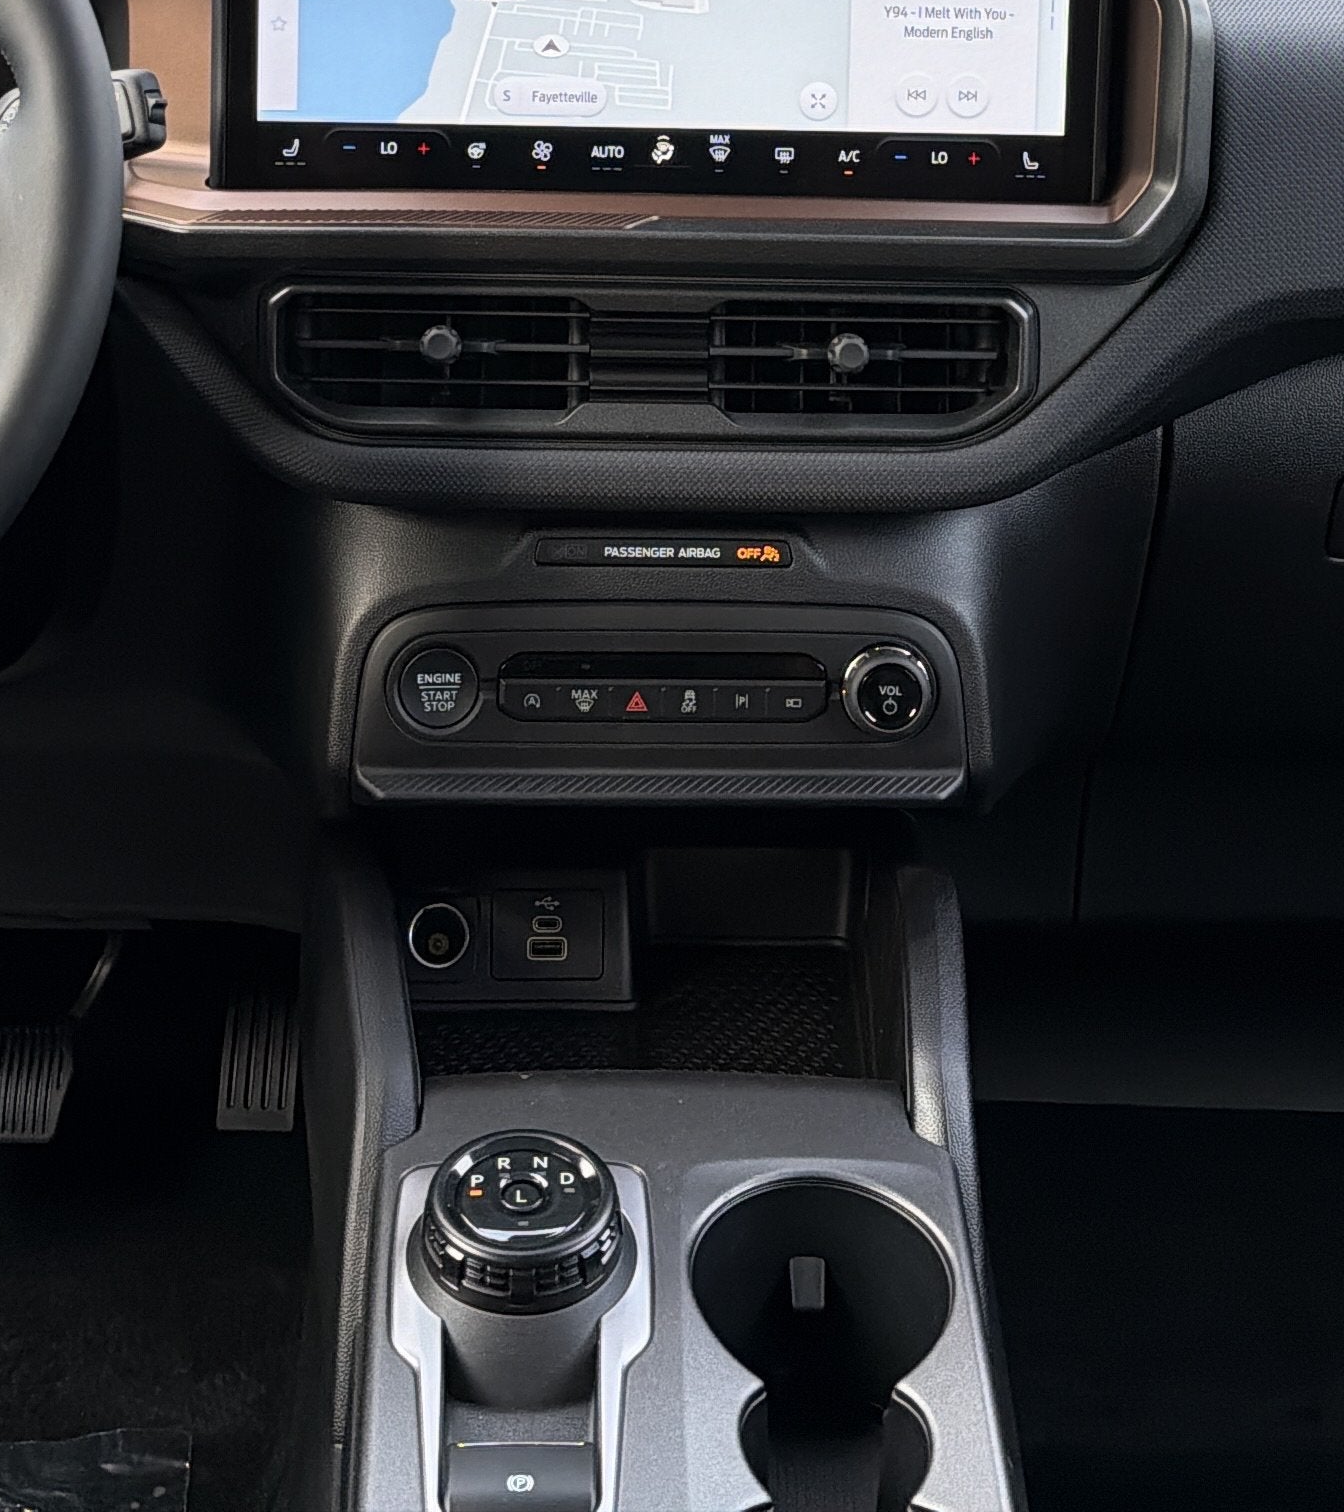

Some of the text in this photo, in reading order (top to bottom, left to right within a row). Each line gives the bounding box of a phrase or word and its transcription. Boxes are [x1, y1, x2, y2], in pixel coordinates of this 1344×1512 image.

[884, 6, 908, 20] Y94
[924, 7, 951, 21] Melt
[953, 7, 982, 21] With
[982, 7, 1008, 21] You
[903, 25, 994, 42] Modern English
[503, 89, 598, 106] S Fayetteville
[709, 134, 730, 146] MAX
[380, 141, 398, 156] LO
[591, 145, 625, 159] AUTO
[838, 149, 861, 164] A/C
[931, 151, 949, 165] LO
[603, 546, 721, 560] PASSENGER AIRBAG
[736, 547, 761, 560] OFF
[416, 672, 462, 685] ENGINE
[420, 690, 459, 702] START
[570, 689, 599, 701] MAX
[878, 685, 903, 697] VOL
[423, 700, 456, 713] STOP
[680, 704, 698, 714] OFF
[497, 1157, 511, 1170] R
[533, 1156, 548, 1169] N
[470, 1174, 485, 1188] P
[560, 1172, 575, 1186] D
[516, 1190, 528, 1203] L
